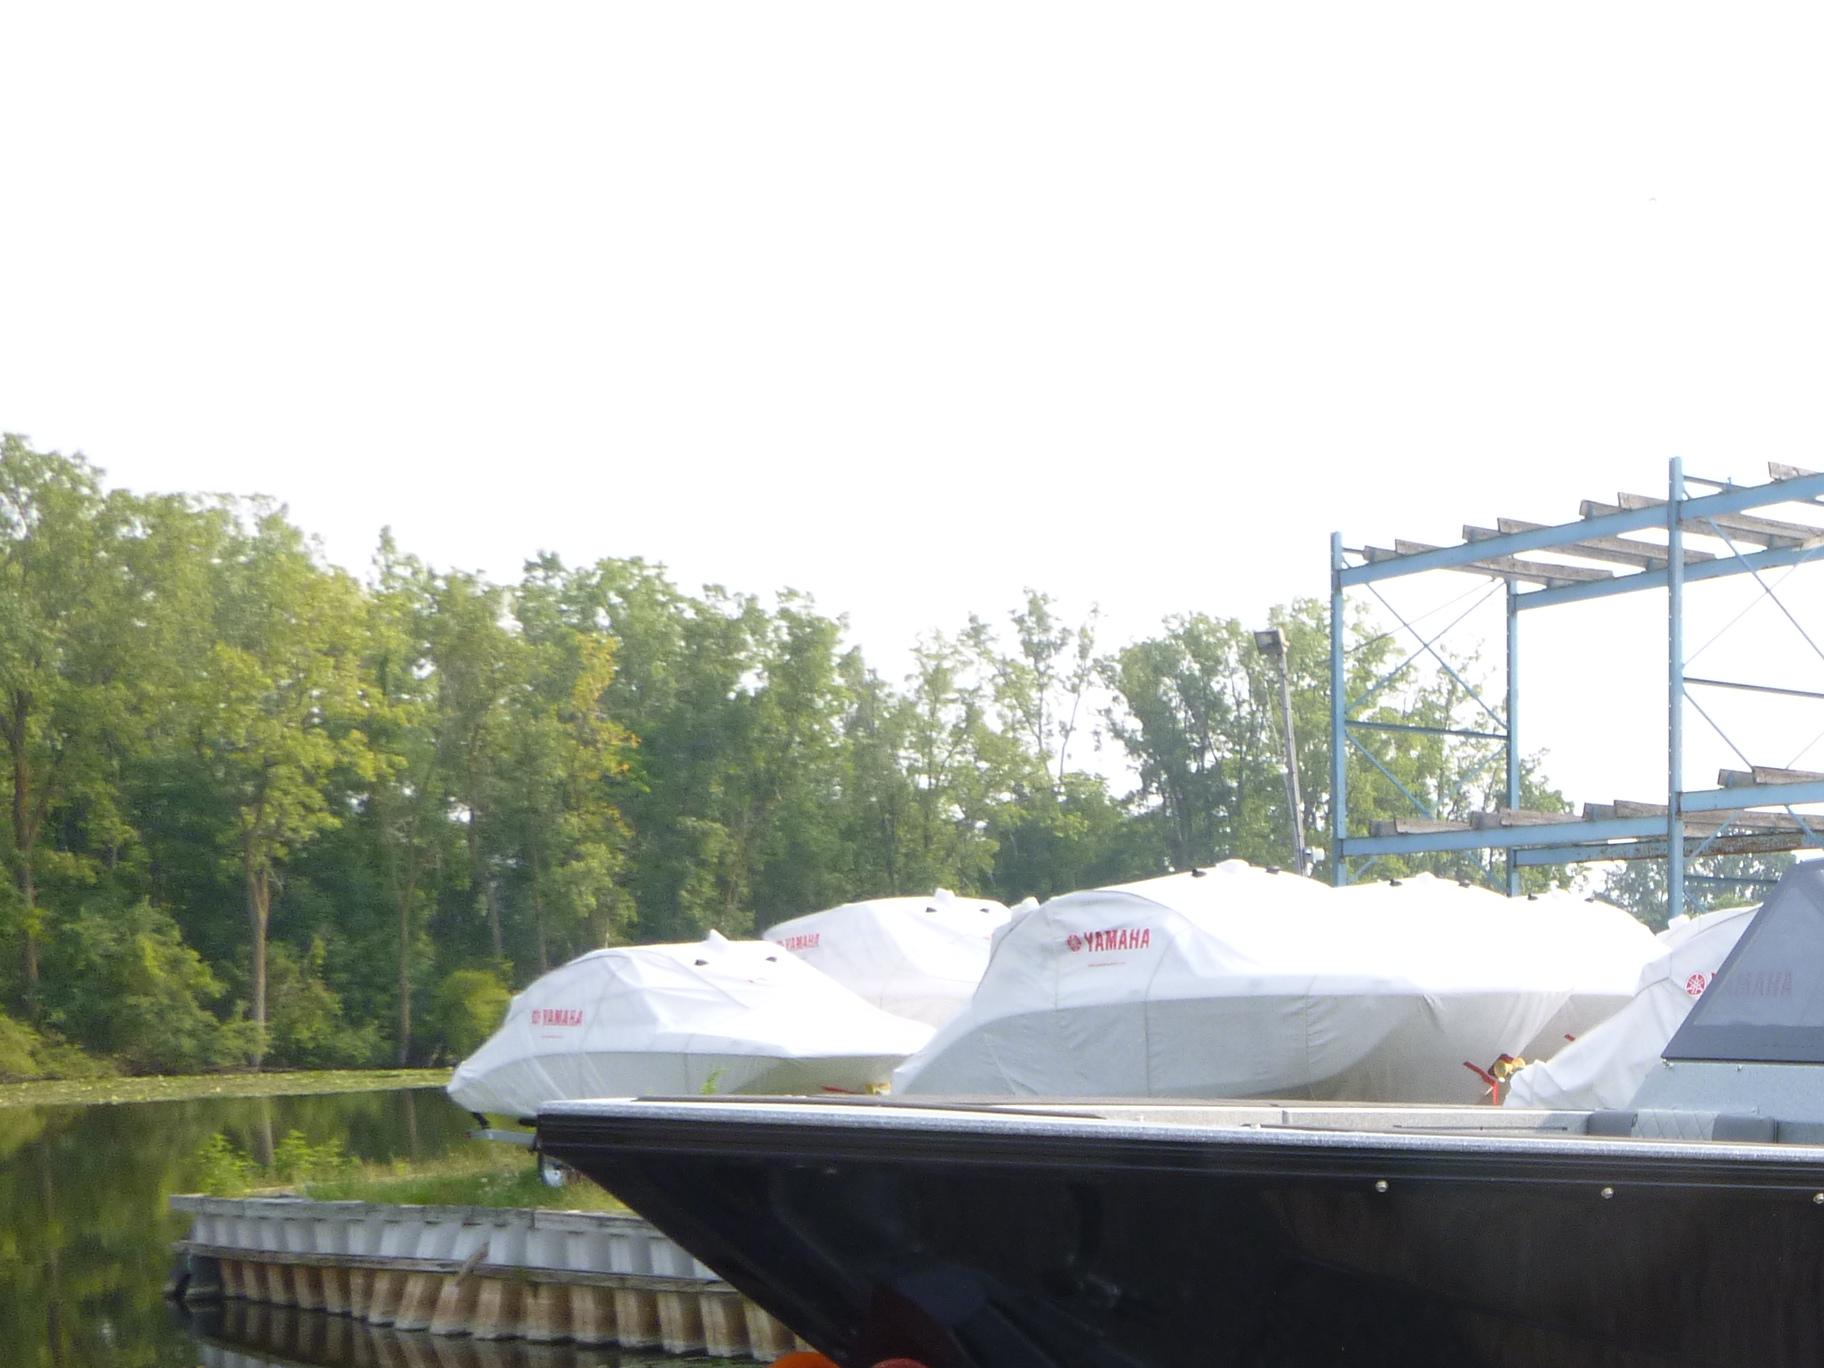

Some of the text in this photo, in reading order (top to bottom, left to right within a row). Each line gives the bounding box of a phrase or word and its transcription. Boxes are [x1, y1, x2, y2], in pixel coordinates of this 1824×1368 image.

[785, 933, 820, 952] YAMAHA
[1083, 927, 1151, 953] YAMAHA
[543, 1008, 583, 1027] YAMAHA
